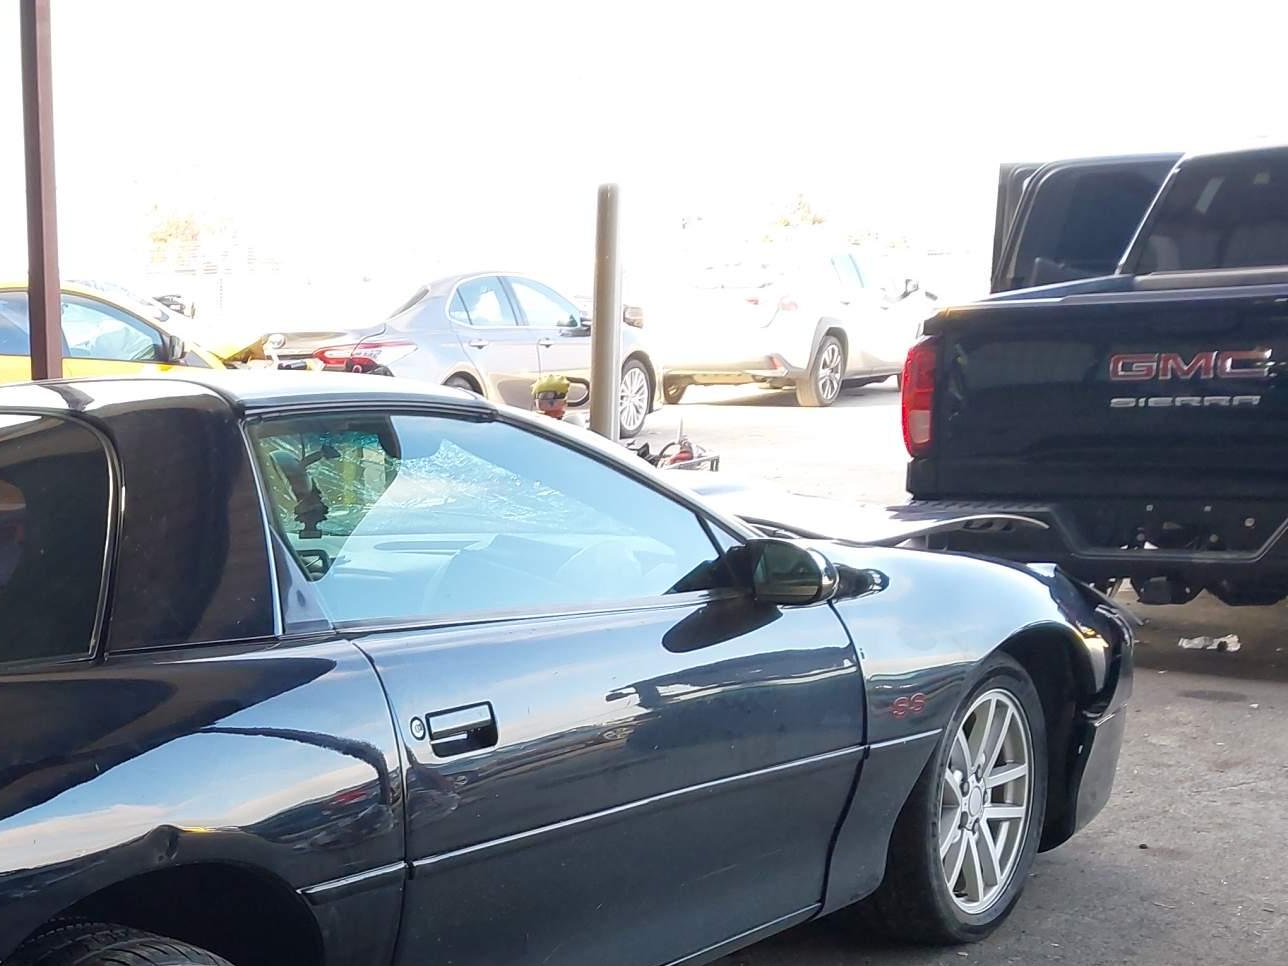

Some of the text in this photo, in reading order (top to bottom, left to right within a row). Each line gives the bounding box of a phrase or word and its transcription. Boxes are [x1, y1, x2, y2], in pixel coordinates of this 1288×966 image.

[1109, 349, 1268, 381] GMC
[1110, 395, 1261, 408] SIERRA
[892, 692, 926, 719] SS
